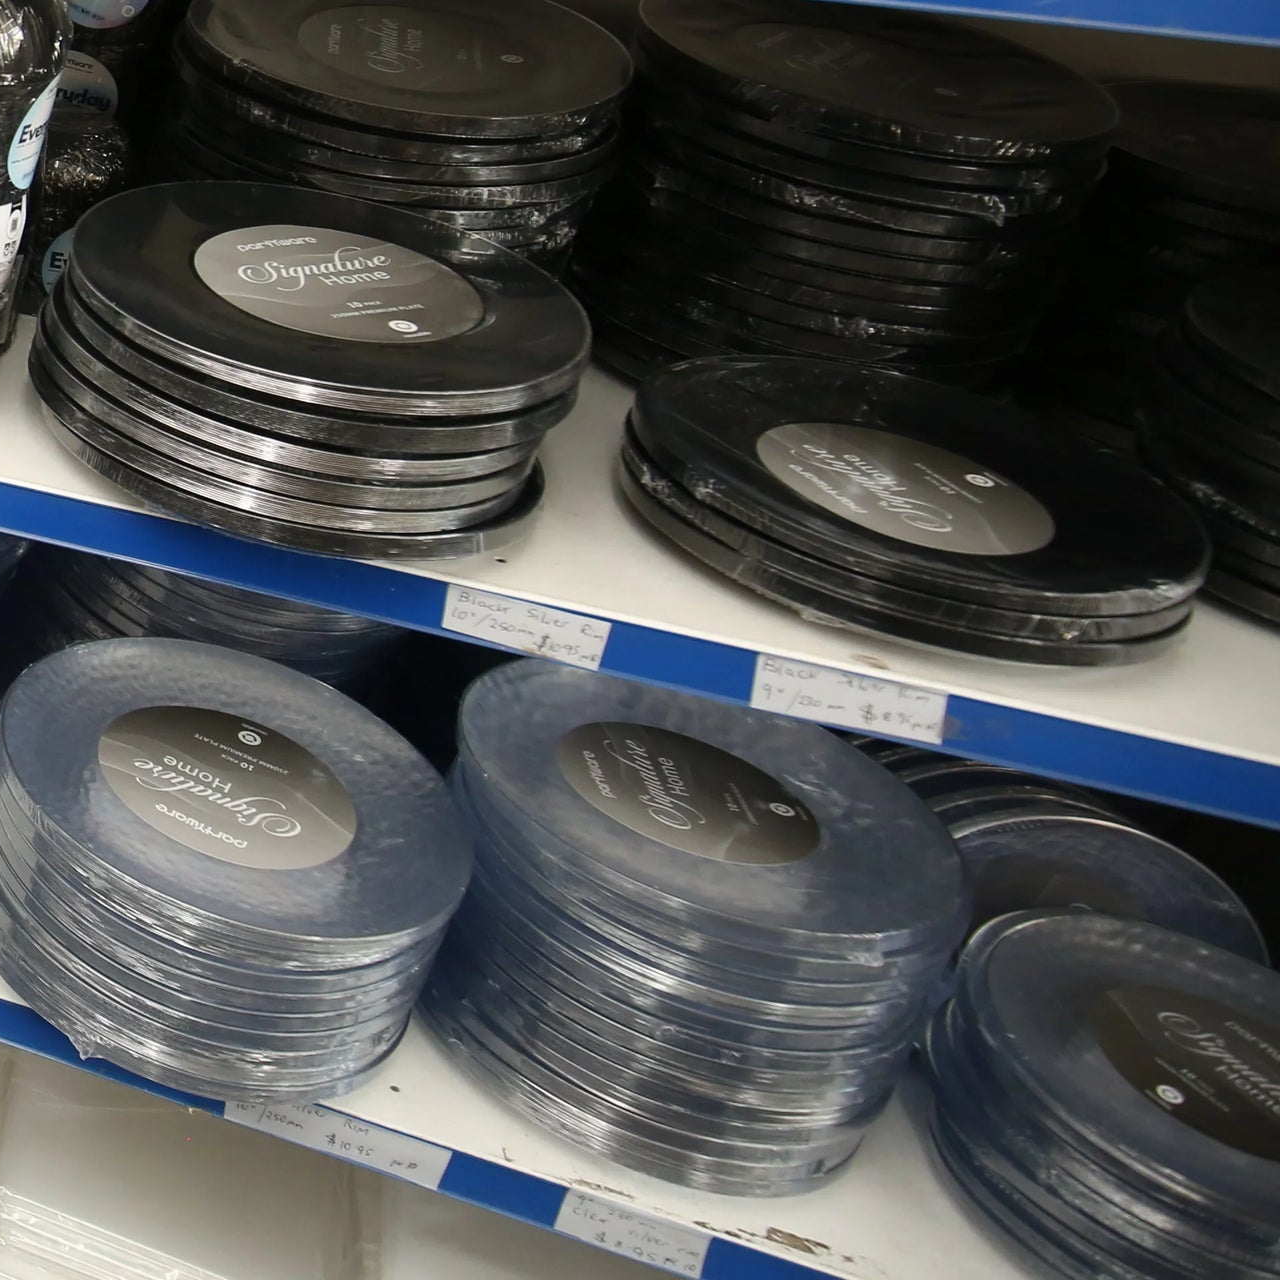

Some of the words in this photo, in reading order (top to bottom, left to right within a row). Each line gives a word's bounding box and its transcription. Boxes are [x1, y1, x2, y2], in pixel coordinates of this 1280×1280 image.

[368, 16, 424, 73] Signature
[237, 246, 392, 292] Signature
[320, 270, 391, 286] Home
[456, 590, 510, 616] Black
[764, 660, 818, 680] Black
[163, 753, 231, 793] Home
[238, 760, 255, 772] 10
[603, 737, 705, 831] Signature
[661, 756, 691, 798] Home
[133, 756, 302, 839] Signature
